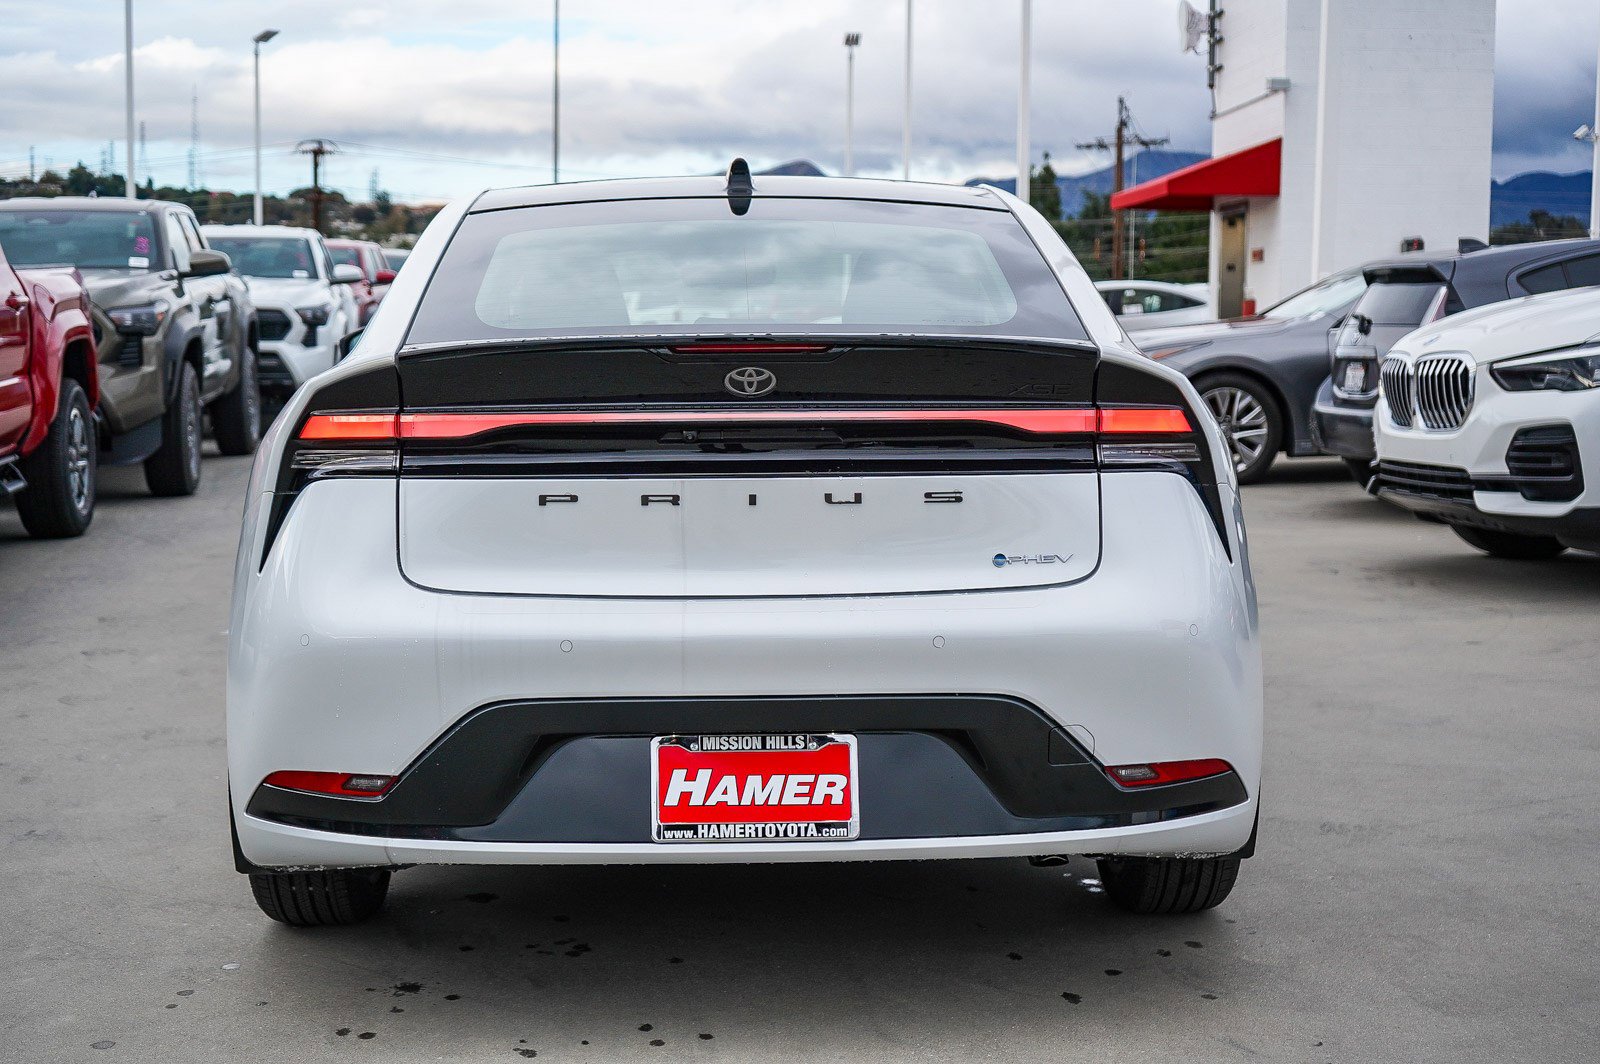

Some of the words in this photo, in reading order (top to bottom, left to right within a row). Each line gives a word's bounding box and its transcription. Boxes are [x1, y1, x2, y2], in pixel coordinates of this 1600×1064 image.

[1008, 384, 1072, 396] XSE
[538, 491, 964, 507] PRIUS
[1006, 553, 1074, 565] PHEV
[702, 736, 763, 750] MISSION
[765, 735, 805, 749] HILLS
[663, 768, 848, 807] HAMER
[663, 823, 848, 839] www.HAMERTOYOTA.com
